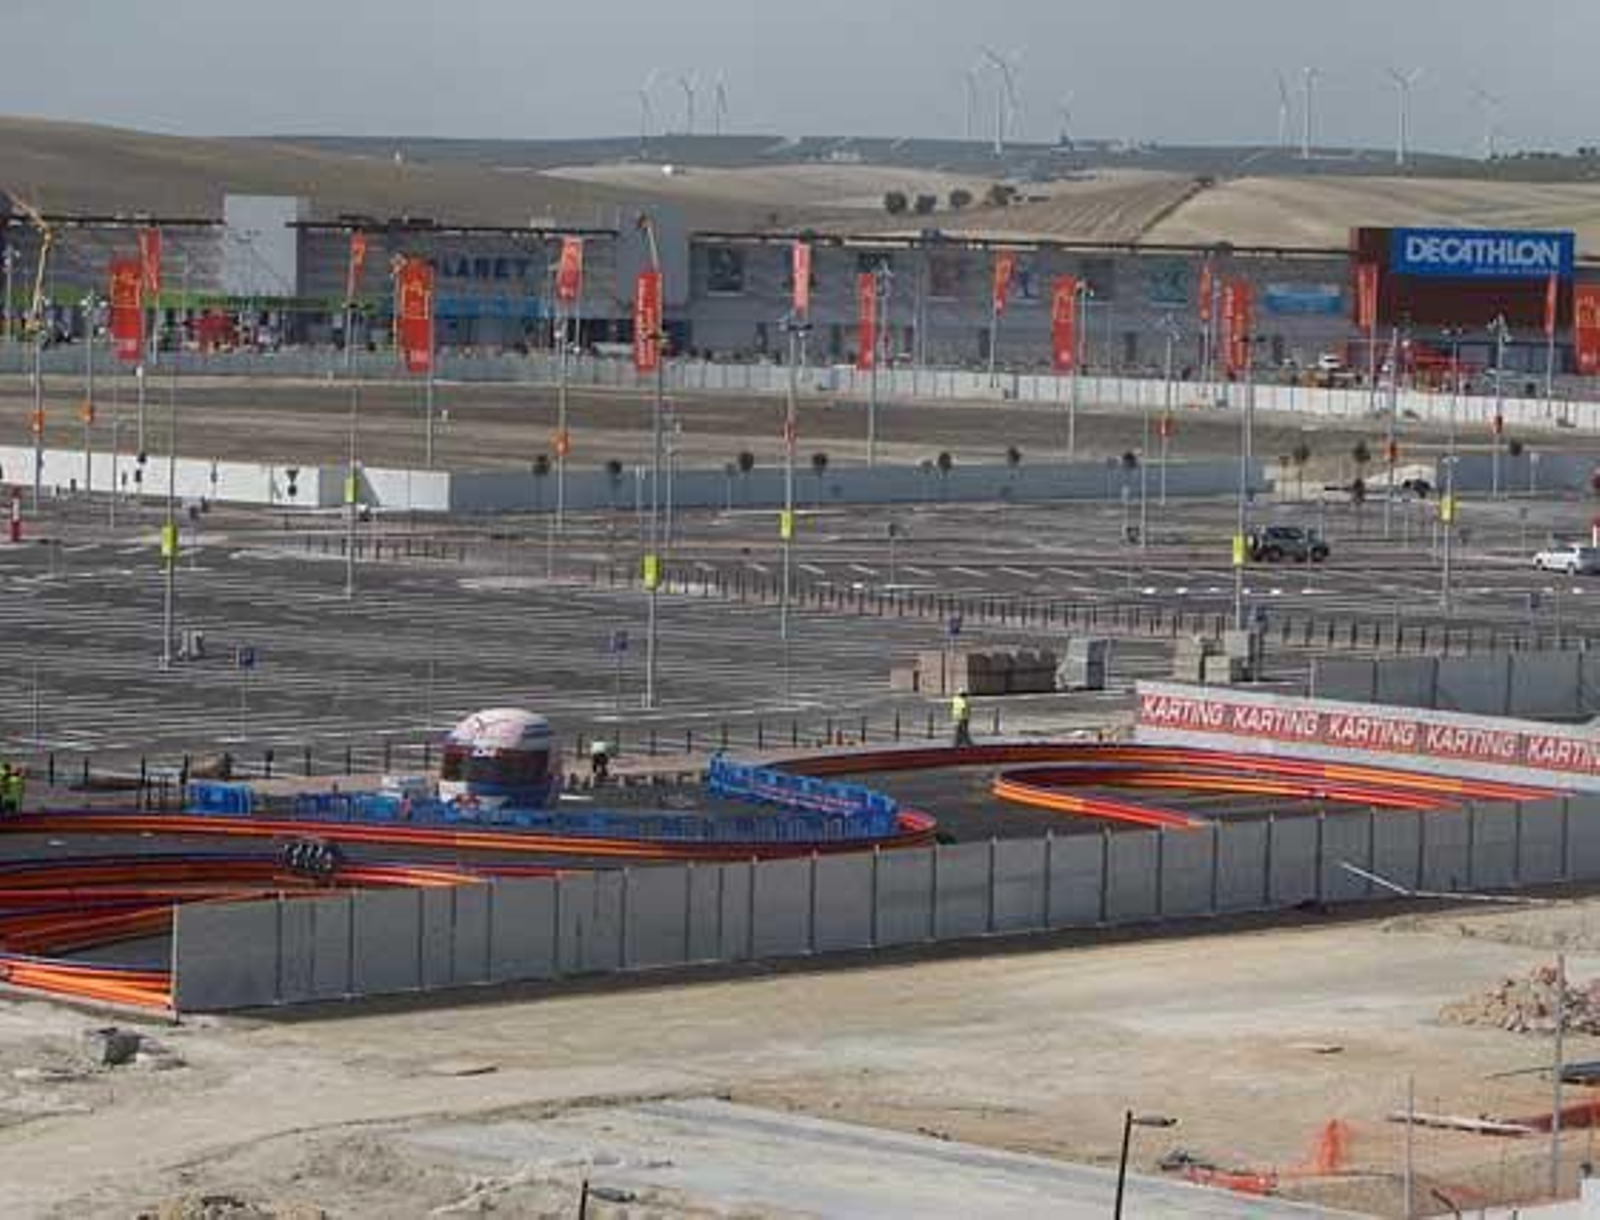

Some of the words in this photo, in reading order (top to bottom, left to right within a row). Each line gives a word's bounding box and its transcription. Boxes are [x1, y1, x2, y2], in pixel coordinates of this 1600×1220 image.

[1407, 237, 1560, 265] DECATHLON
[1143, 696, 1224, 725] KARTING
[1233, 705, 1318, 735] KARTING
[1329, 713, 1416, 745] KARTING
[1427, 724, 1515, 757] KARTING
